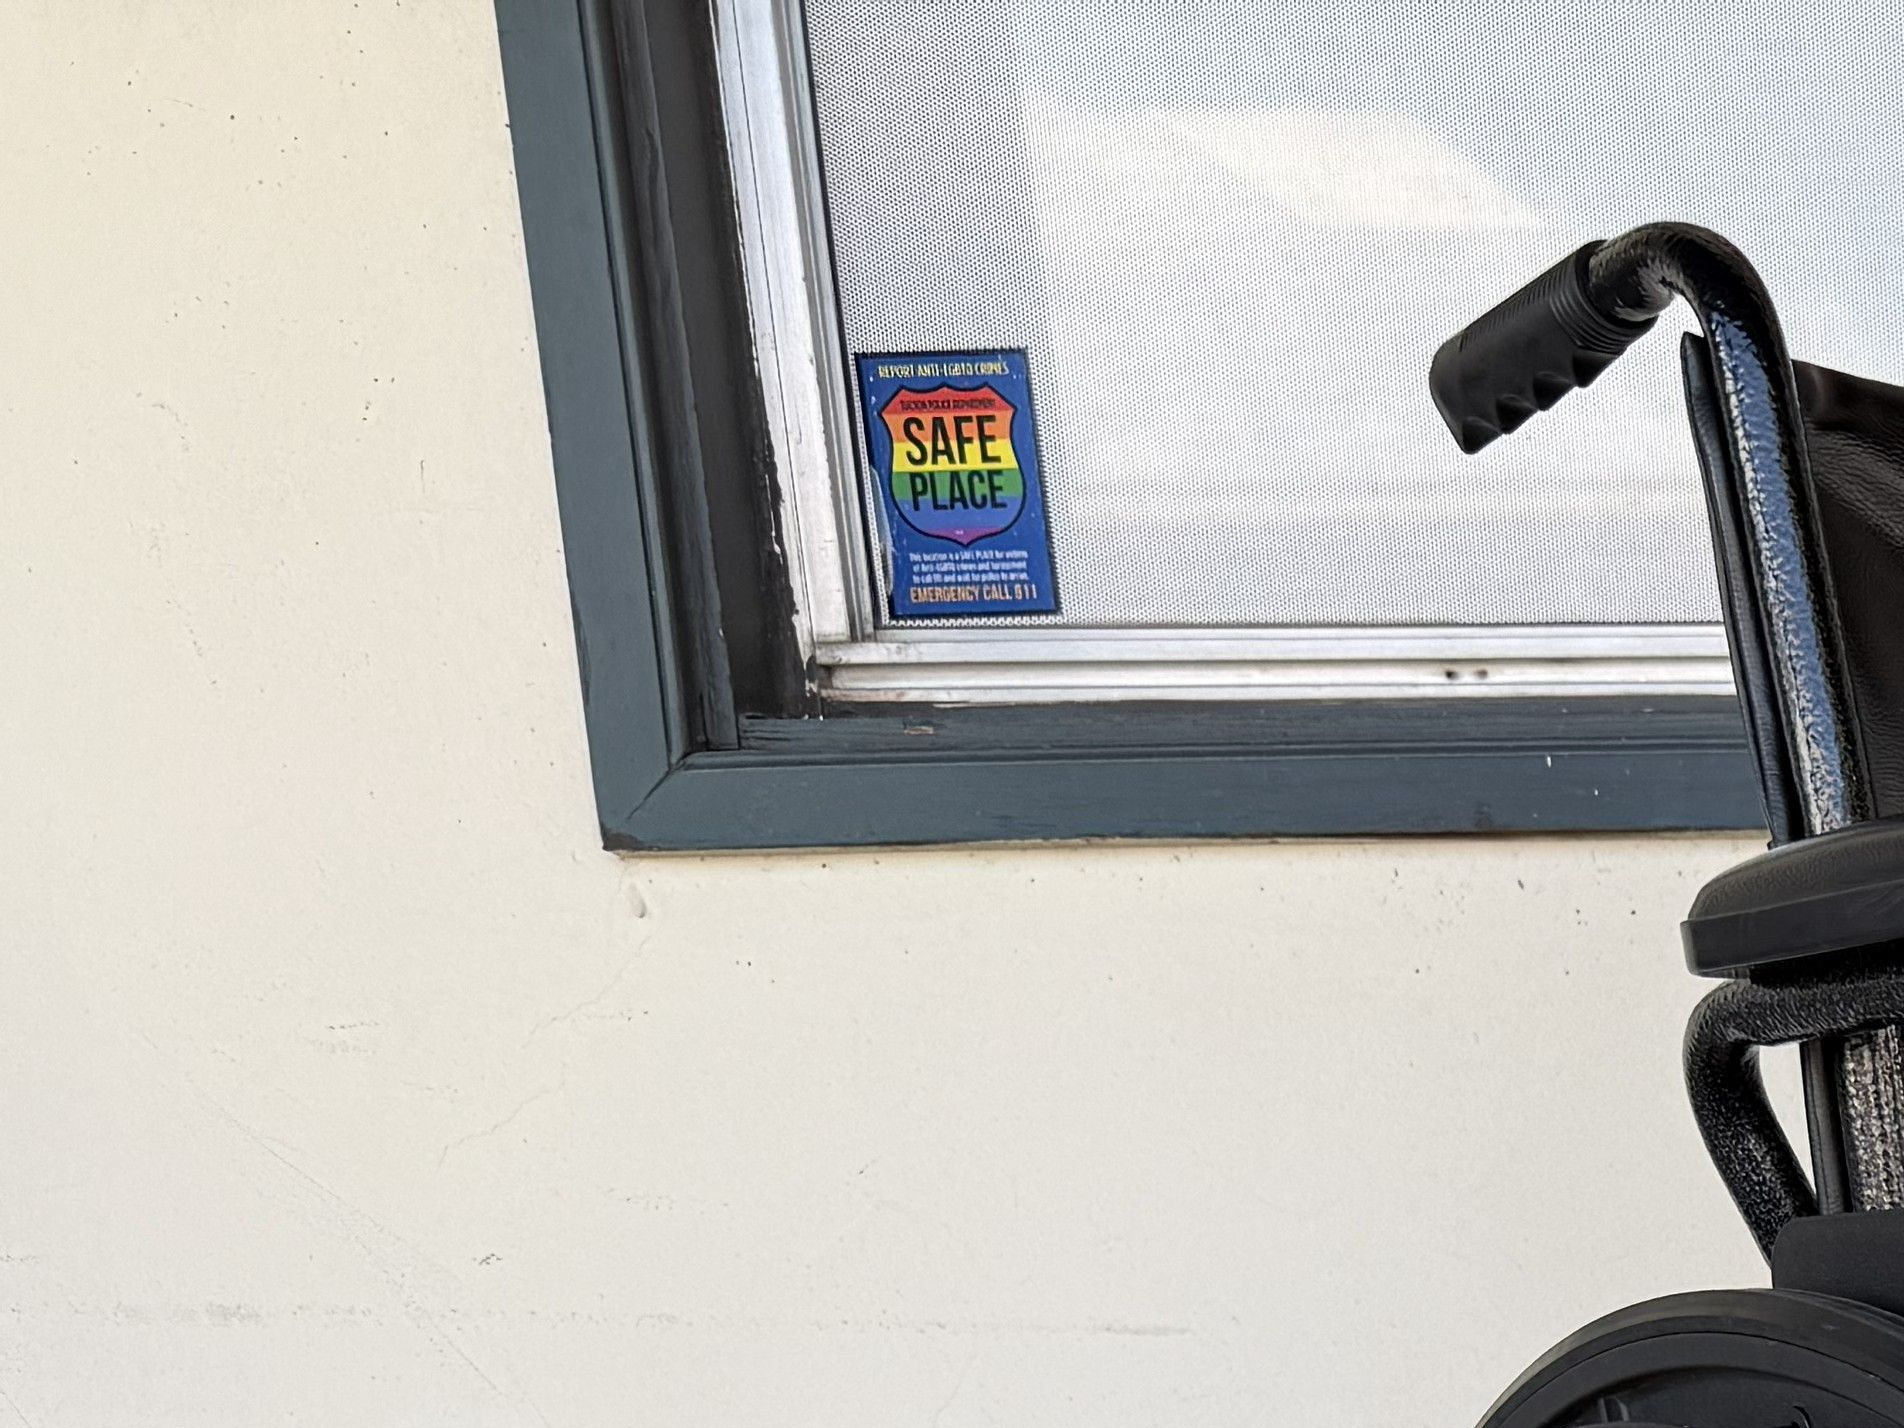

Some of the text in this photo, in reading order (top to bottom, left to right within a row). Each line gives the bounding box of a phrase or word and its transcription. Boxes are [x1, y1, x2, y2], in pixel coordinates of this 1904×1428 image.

[903, 415, 1002, 466] SAFE
[910, 469, 1008, 512] PLACE
[910, 585, 980, 603] EMERGENCY
[983, 583, 1012, 600] CALL
